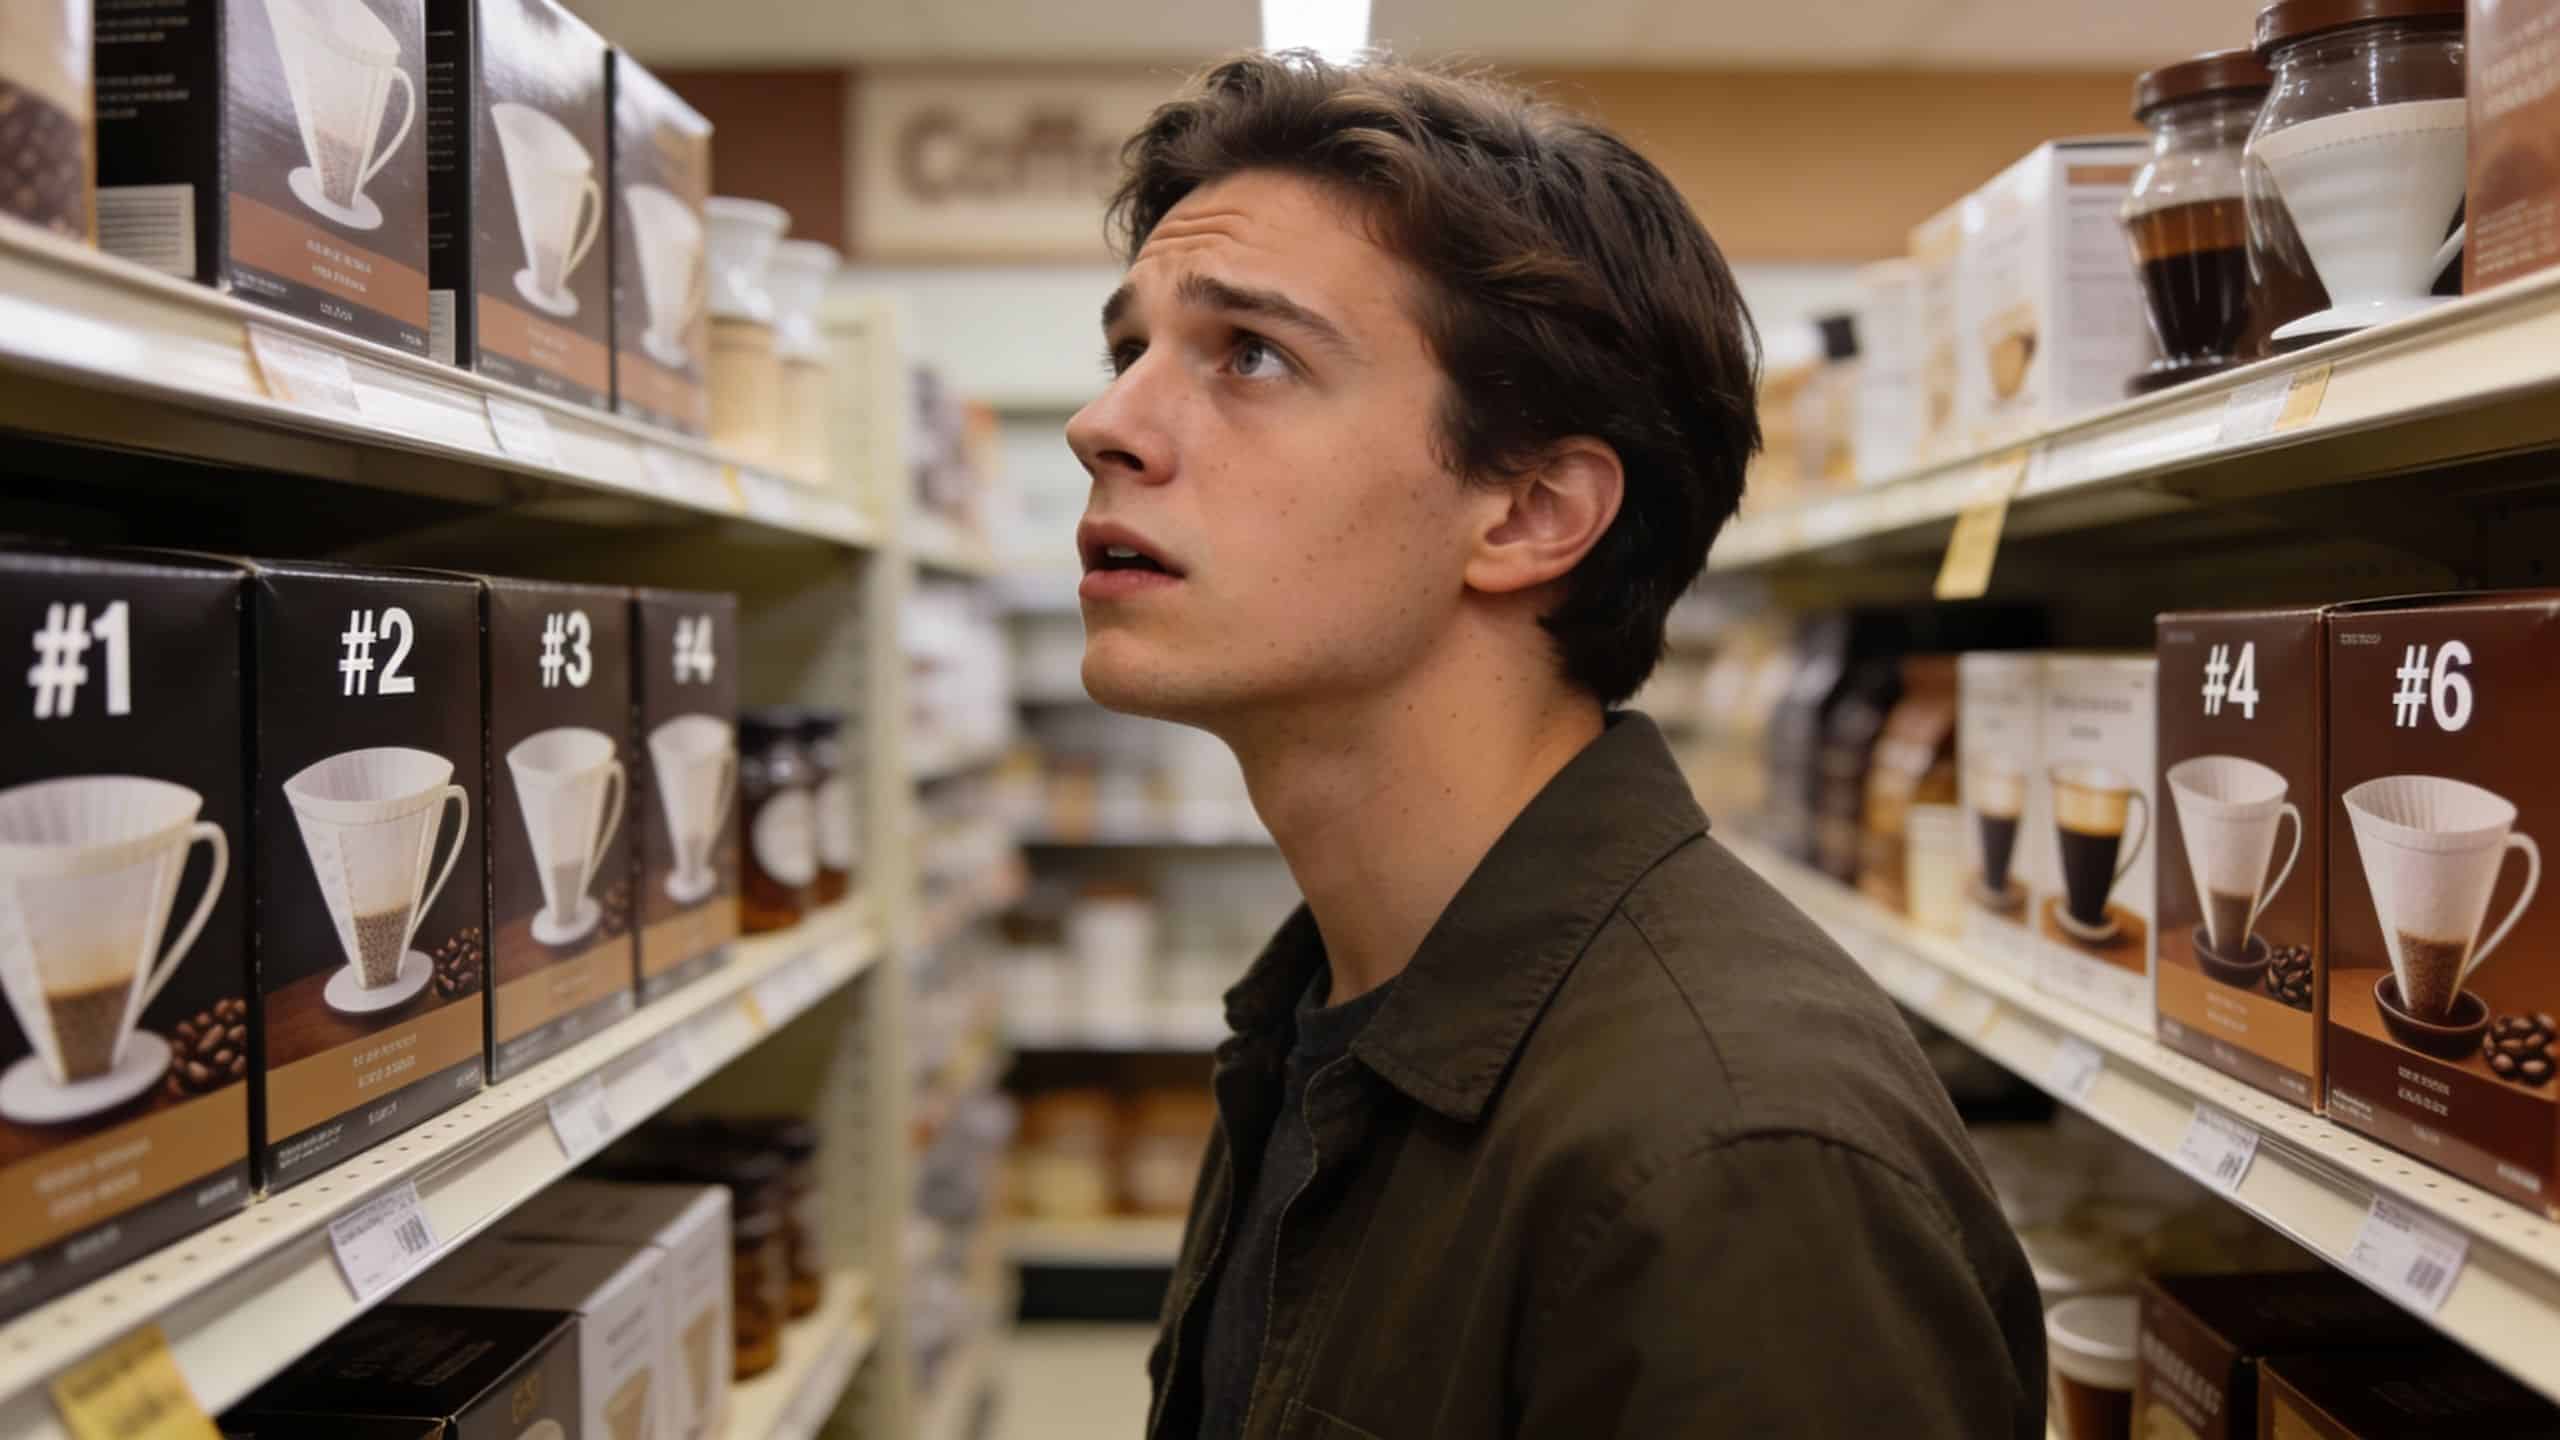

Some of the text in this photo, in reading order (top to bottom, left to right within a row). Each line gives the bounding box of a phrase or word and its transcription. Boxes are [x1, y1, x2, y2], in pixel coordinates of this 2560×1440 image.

[29, 602, 131, 718] #1
[339, 607, 415, 696] #2
[540, 610, 592, 687] #3
[673, 615, 716, 683] #4
[2202, 641, 2260, 719] #4
[2393, 640, 2472, 731] #6
